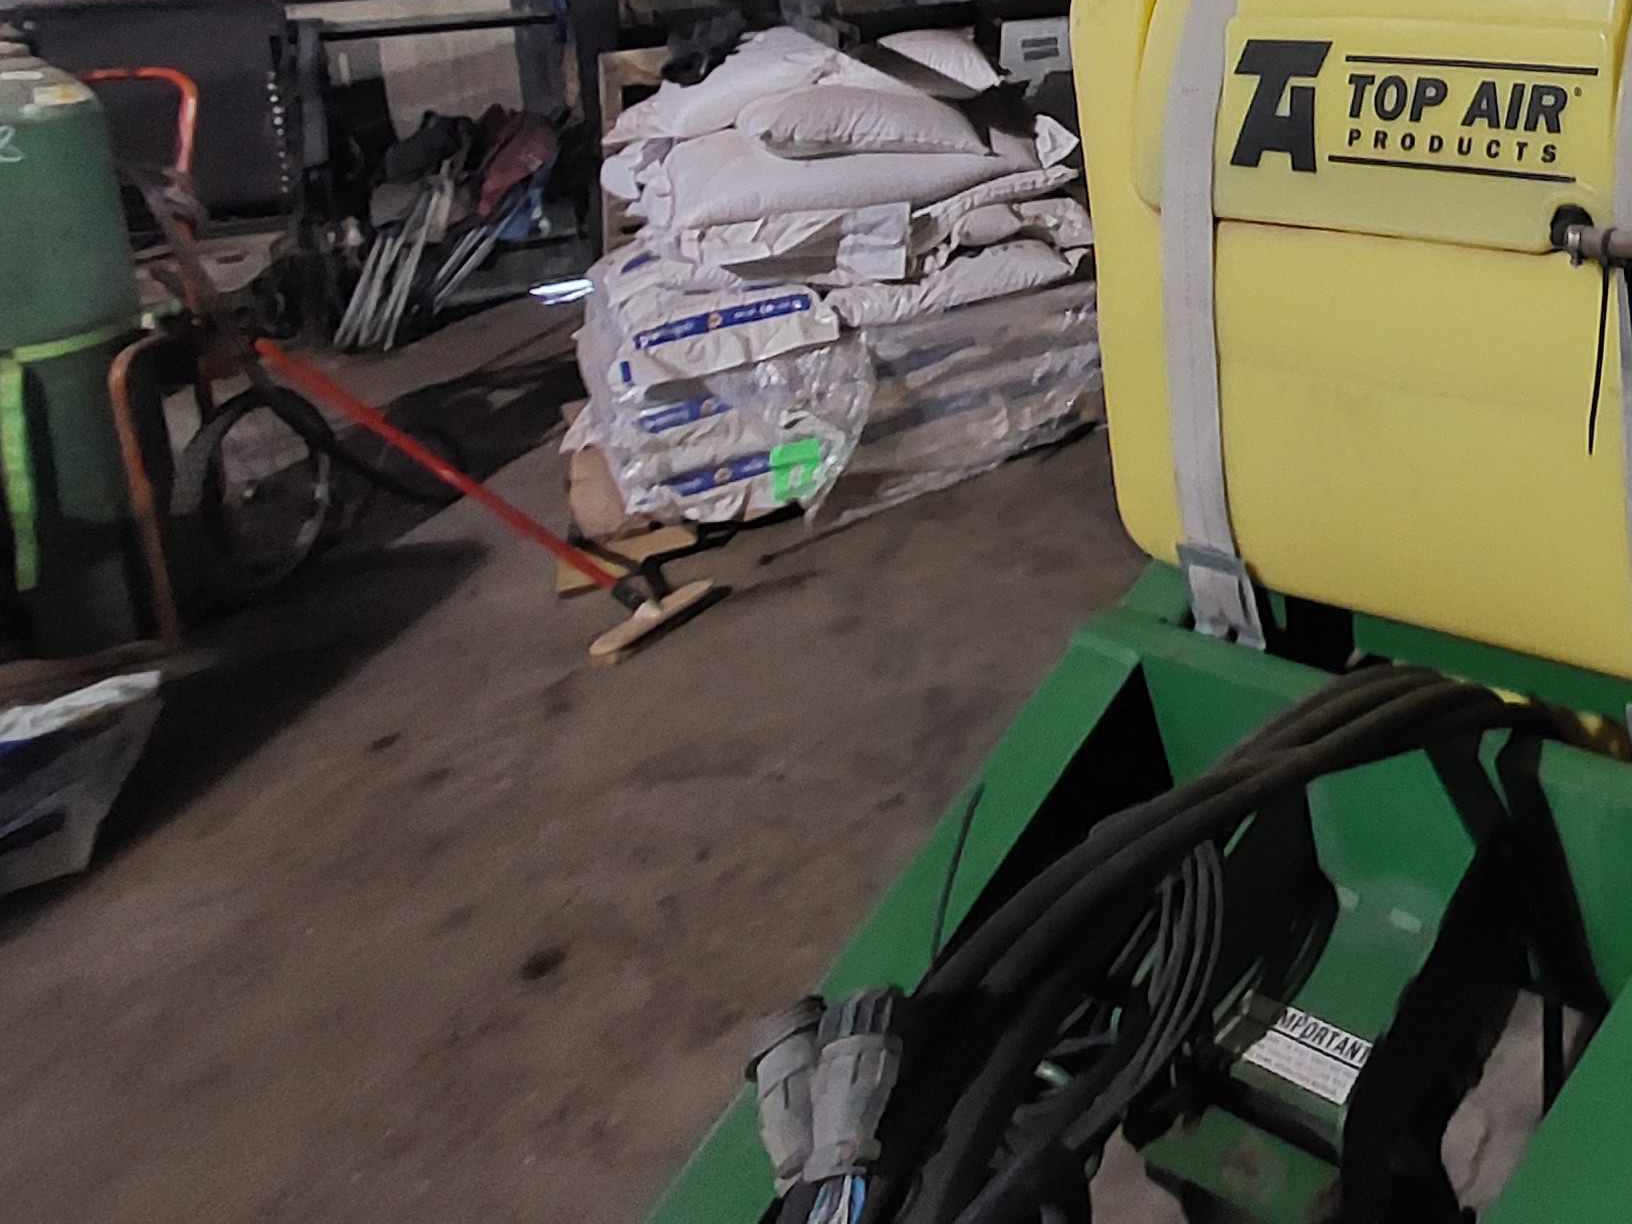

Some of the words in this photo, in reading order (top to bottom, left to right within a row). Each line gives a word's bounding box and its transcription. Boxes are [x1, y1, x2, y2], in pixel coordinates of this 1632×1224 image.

[1347, 73, 1449, 124] TOP
[1347, 128, 1558, 164] PRODUCTS
[1279, 1011, 1369, 1064] MPORTANT
